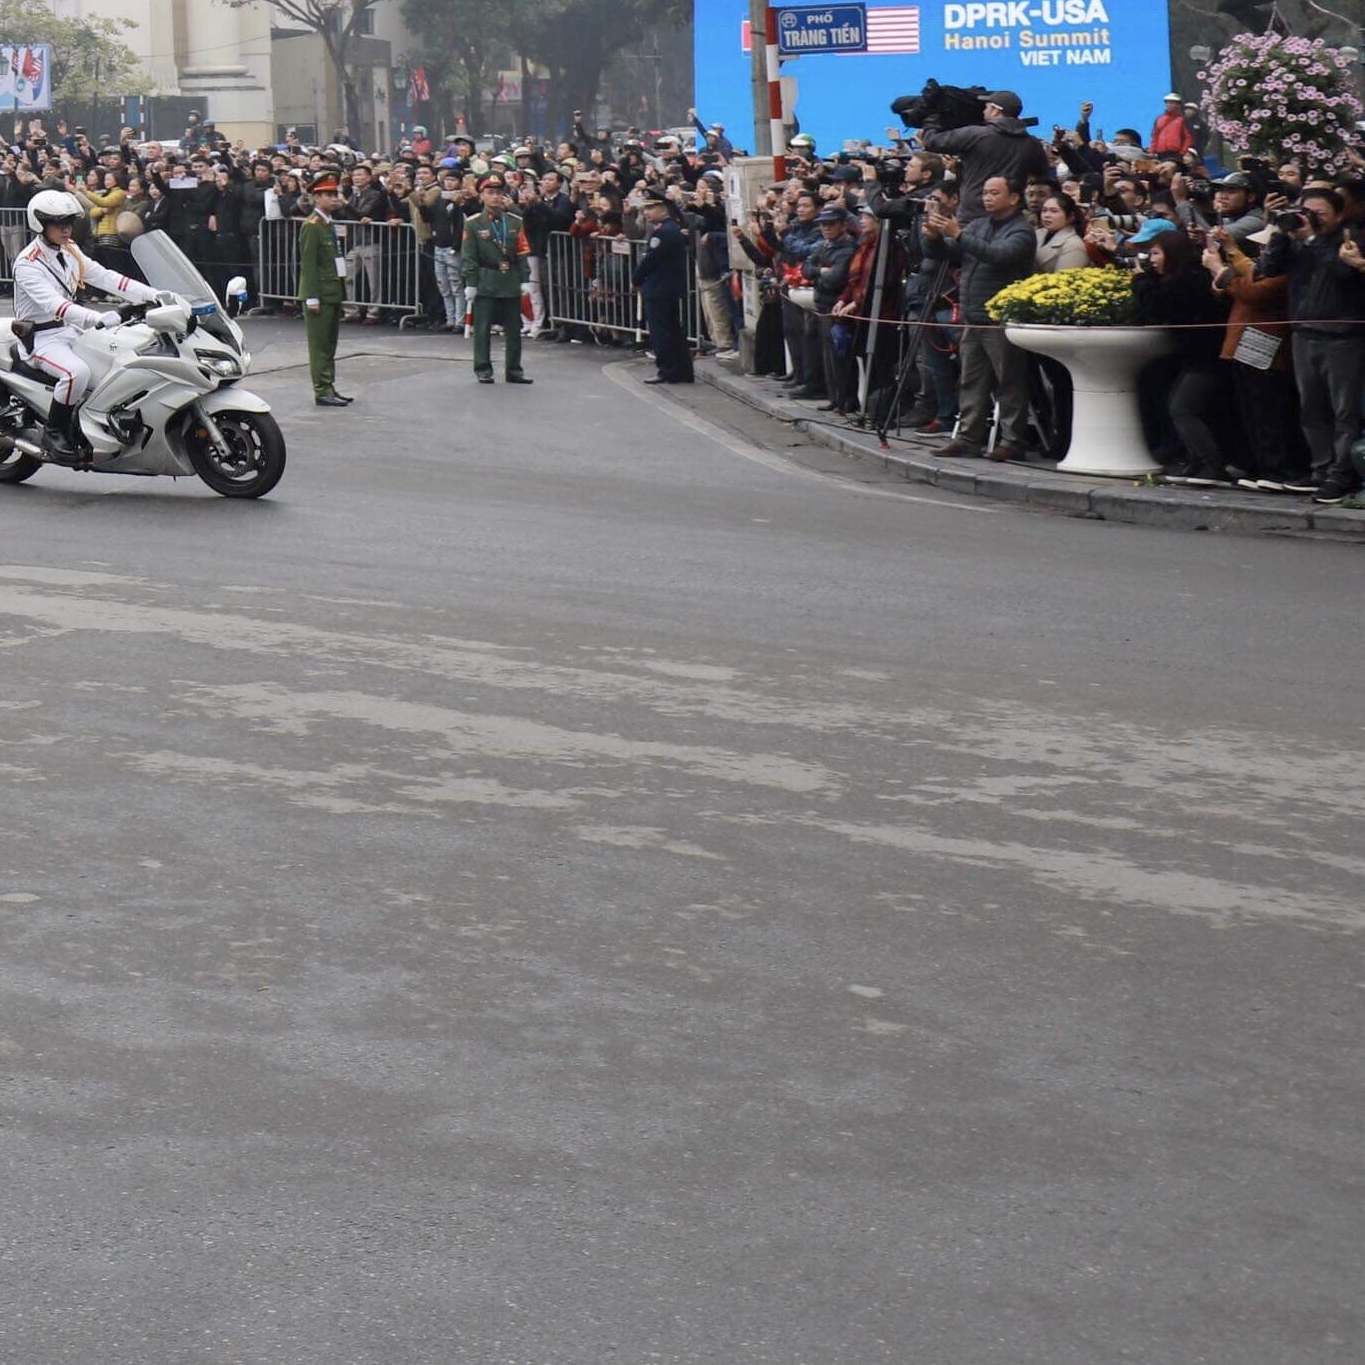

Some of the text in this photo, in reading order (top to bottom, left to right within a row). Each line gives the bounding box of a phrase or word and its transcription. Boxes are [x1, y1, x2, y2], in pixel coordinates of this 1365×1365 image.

[806, 11, 833, 24] PHỐ
[783, 26, 827, 47] TRÀNG
[944, 28, 1110, 50] Hanoi Summit
[1020, 48, 1111, 67] VIET NAM
